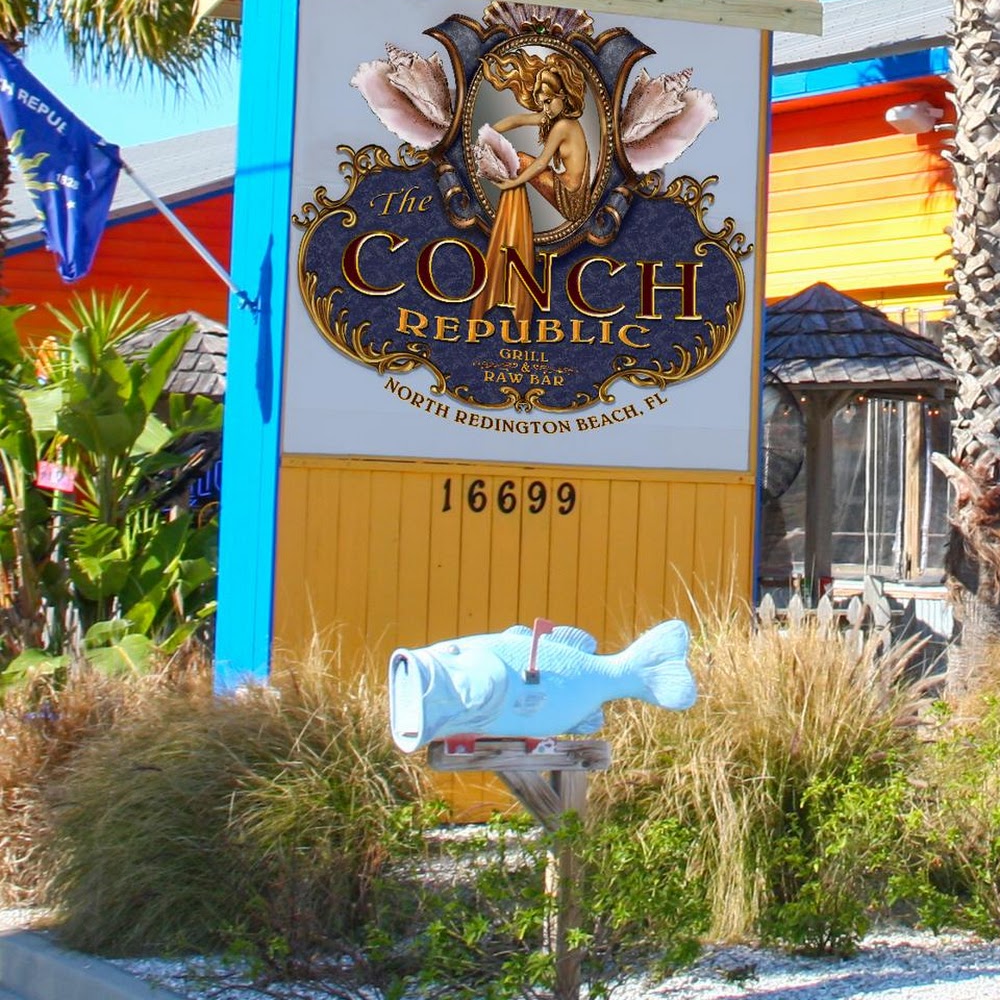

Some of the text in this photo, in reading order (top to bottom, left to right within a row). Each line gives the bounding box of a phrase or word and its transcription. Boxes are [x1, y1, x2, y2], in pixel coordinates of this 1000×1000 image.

[369, 187, 432, 217] The
[341, 231, 704, 321] CONCH
[395, 307, 652, 349] REPUBLIC
[499, 348, 549, 363] GRILL
[520, 361, 531, 373] &
[483, 370, 565, 387] RAW BAR
[383, 376, 668, 434] NORTH REDINGTON BEACH, FL
[441, 478, 577, 516] 16699
